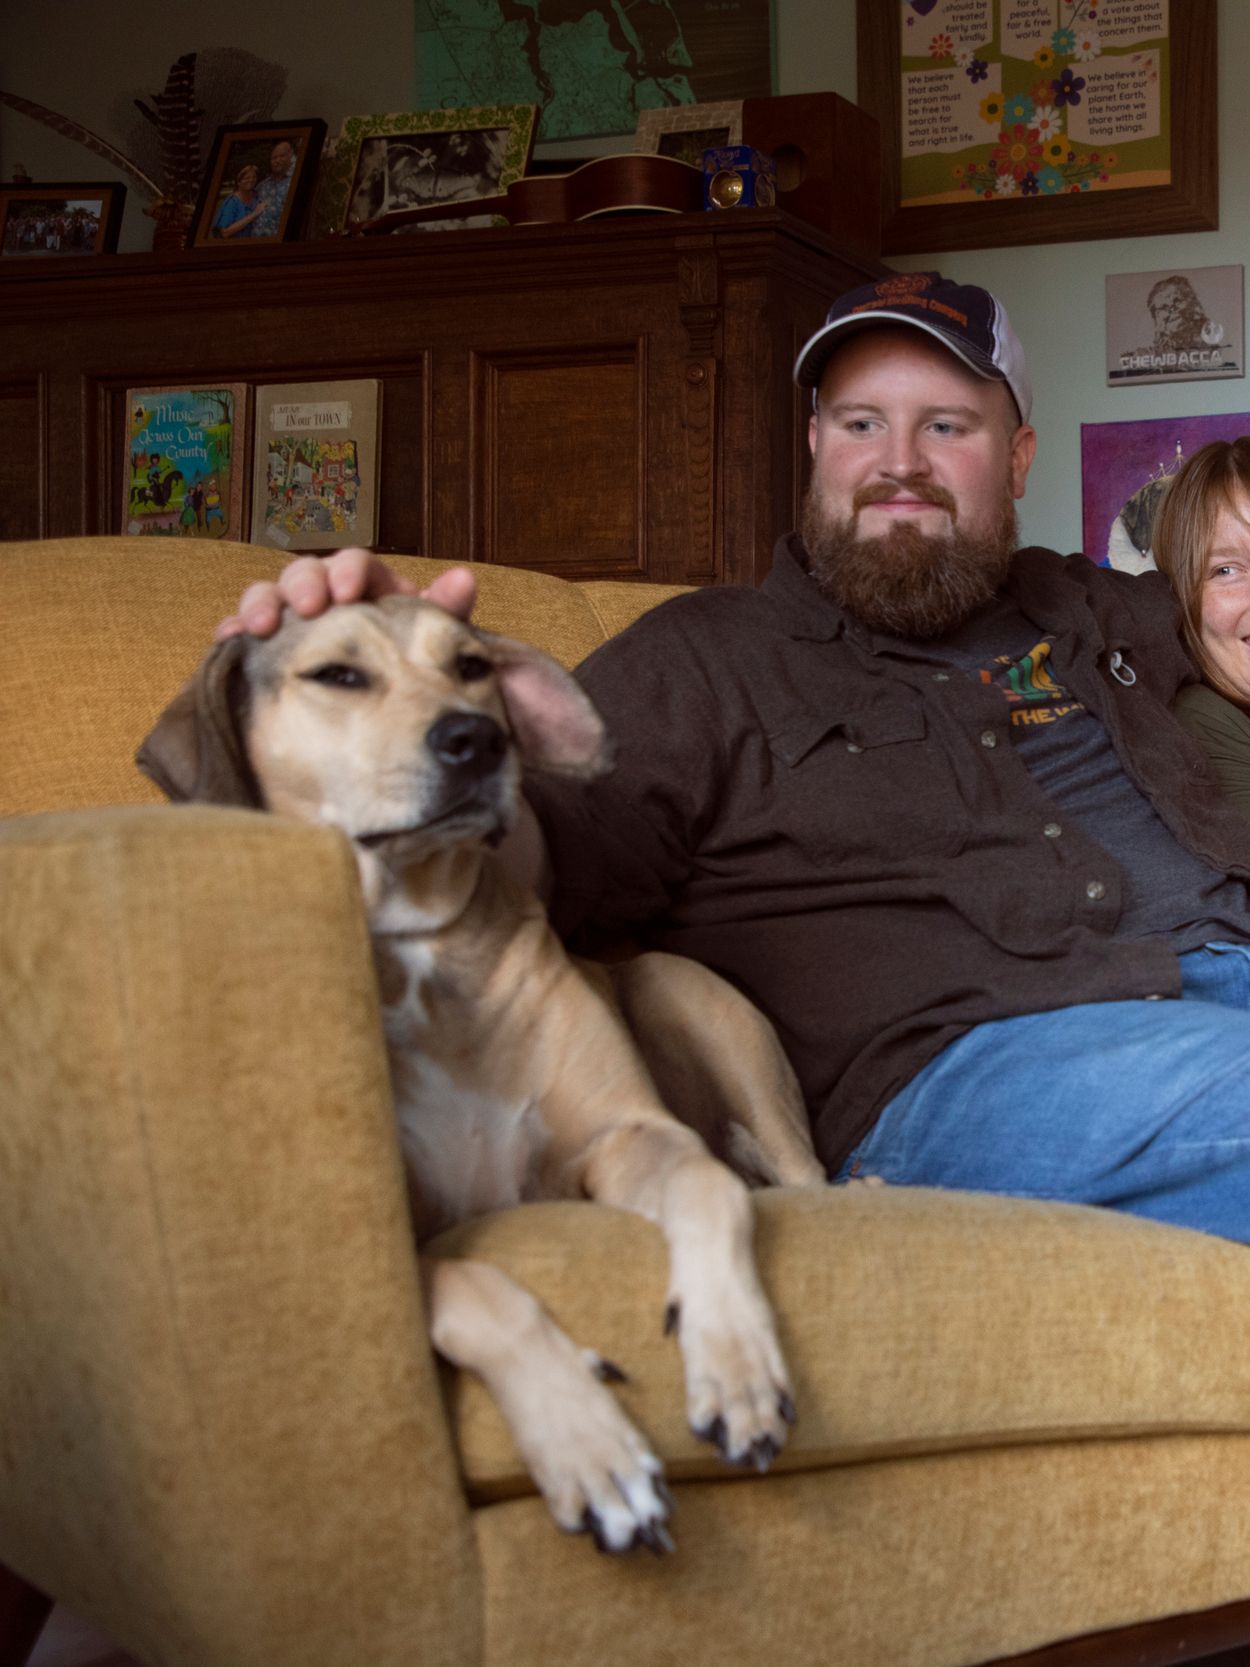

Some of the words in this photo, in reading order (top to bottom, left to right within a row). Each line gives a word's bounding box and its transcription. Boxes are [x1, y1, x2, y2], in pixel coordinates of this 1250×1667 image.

[976, 1, 988, 9] be
[1111, 6, 1131, 14] vote
[1133, 2, 1160, 12] about
[952, 11, 985, 21] treated
[1097, 18, 1112, 26] the
[1114, 15, 1141, 26] things
[1144, 12, 1162, 21] that
[946, 24, 968, 33] fairly
[970, 22, 988, 30] and
[1007, 21, 1021, 30] fair
[1024, 20, 1031, 28] &
[1033, 18, 1052, 27] free
[1098, 27, 1135, 37] concern
[908, 76, 922, 84] We
[924, 73, 955, 83] believe
[1088, 73, 1103, 82] We
[1104, 70, 1136, 80] believe
[1138, 69, 1147, 77] in
[908, 86, 926, 95] that
[928, 84, 949, 93] each
[1087, 83, 1115, 94] caring
[1117, 82, 1130, 91] for
[1133, 80, 1148, 89] our
[908, 95, 939, 106] person
[940, 93, 961, 102] must
[1088, 93, 1116, 104] planet
[908, 107, 920, 116] be
[922, 106, 940, 115] free
[942, 105, 951, 113] to
[1089, 106, 1104, 114] the
[1106, 104, 1131, 113] home
[1133, 102, 1146, 110] we
[908, 115, 938, 126] search
[940, 115, 953, 123] for
[1088, 115, 1113, 126] share
[1116, 113, 1134, 123] with
[1136, 111, 1147, 120] all
[908, 127, 930, 137] what
[932, 125, 939, 134] is
[941, 125, 959, 134] true
[1089, 125, 1113, 137] living
[908, 138, 926, 147] and
[928, 136, 947, 147] right
[949, 134, 958, 143] in
[1119, 350, 1223, 370] CHEWBACCA
[155, 403, 194, 426] Music
[286, 413, 297, 426] IN
[313, 411, 342, 426] TOWN
[139, 428, 175, 446] Across
[177, 426, 204, 444] Our
[165, 441, 215, 464] Country
[1009, 707, 1057, 726] THE
